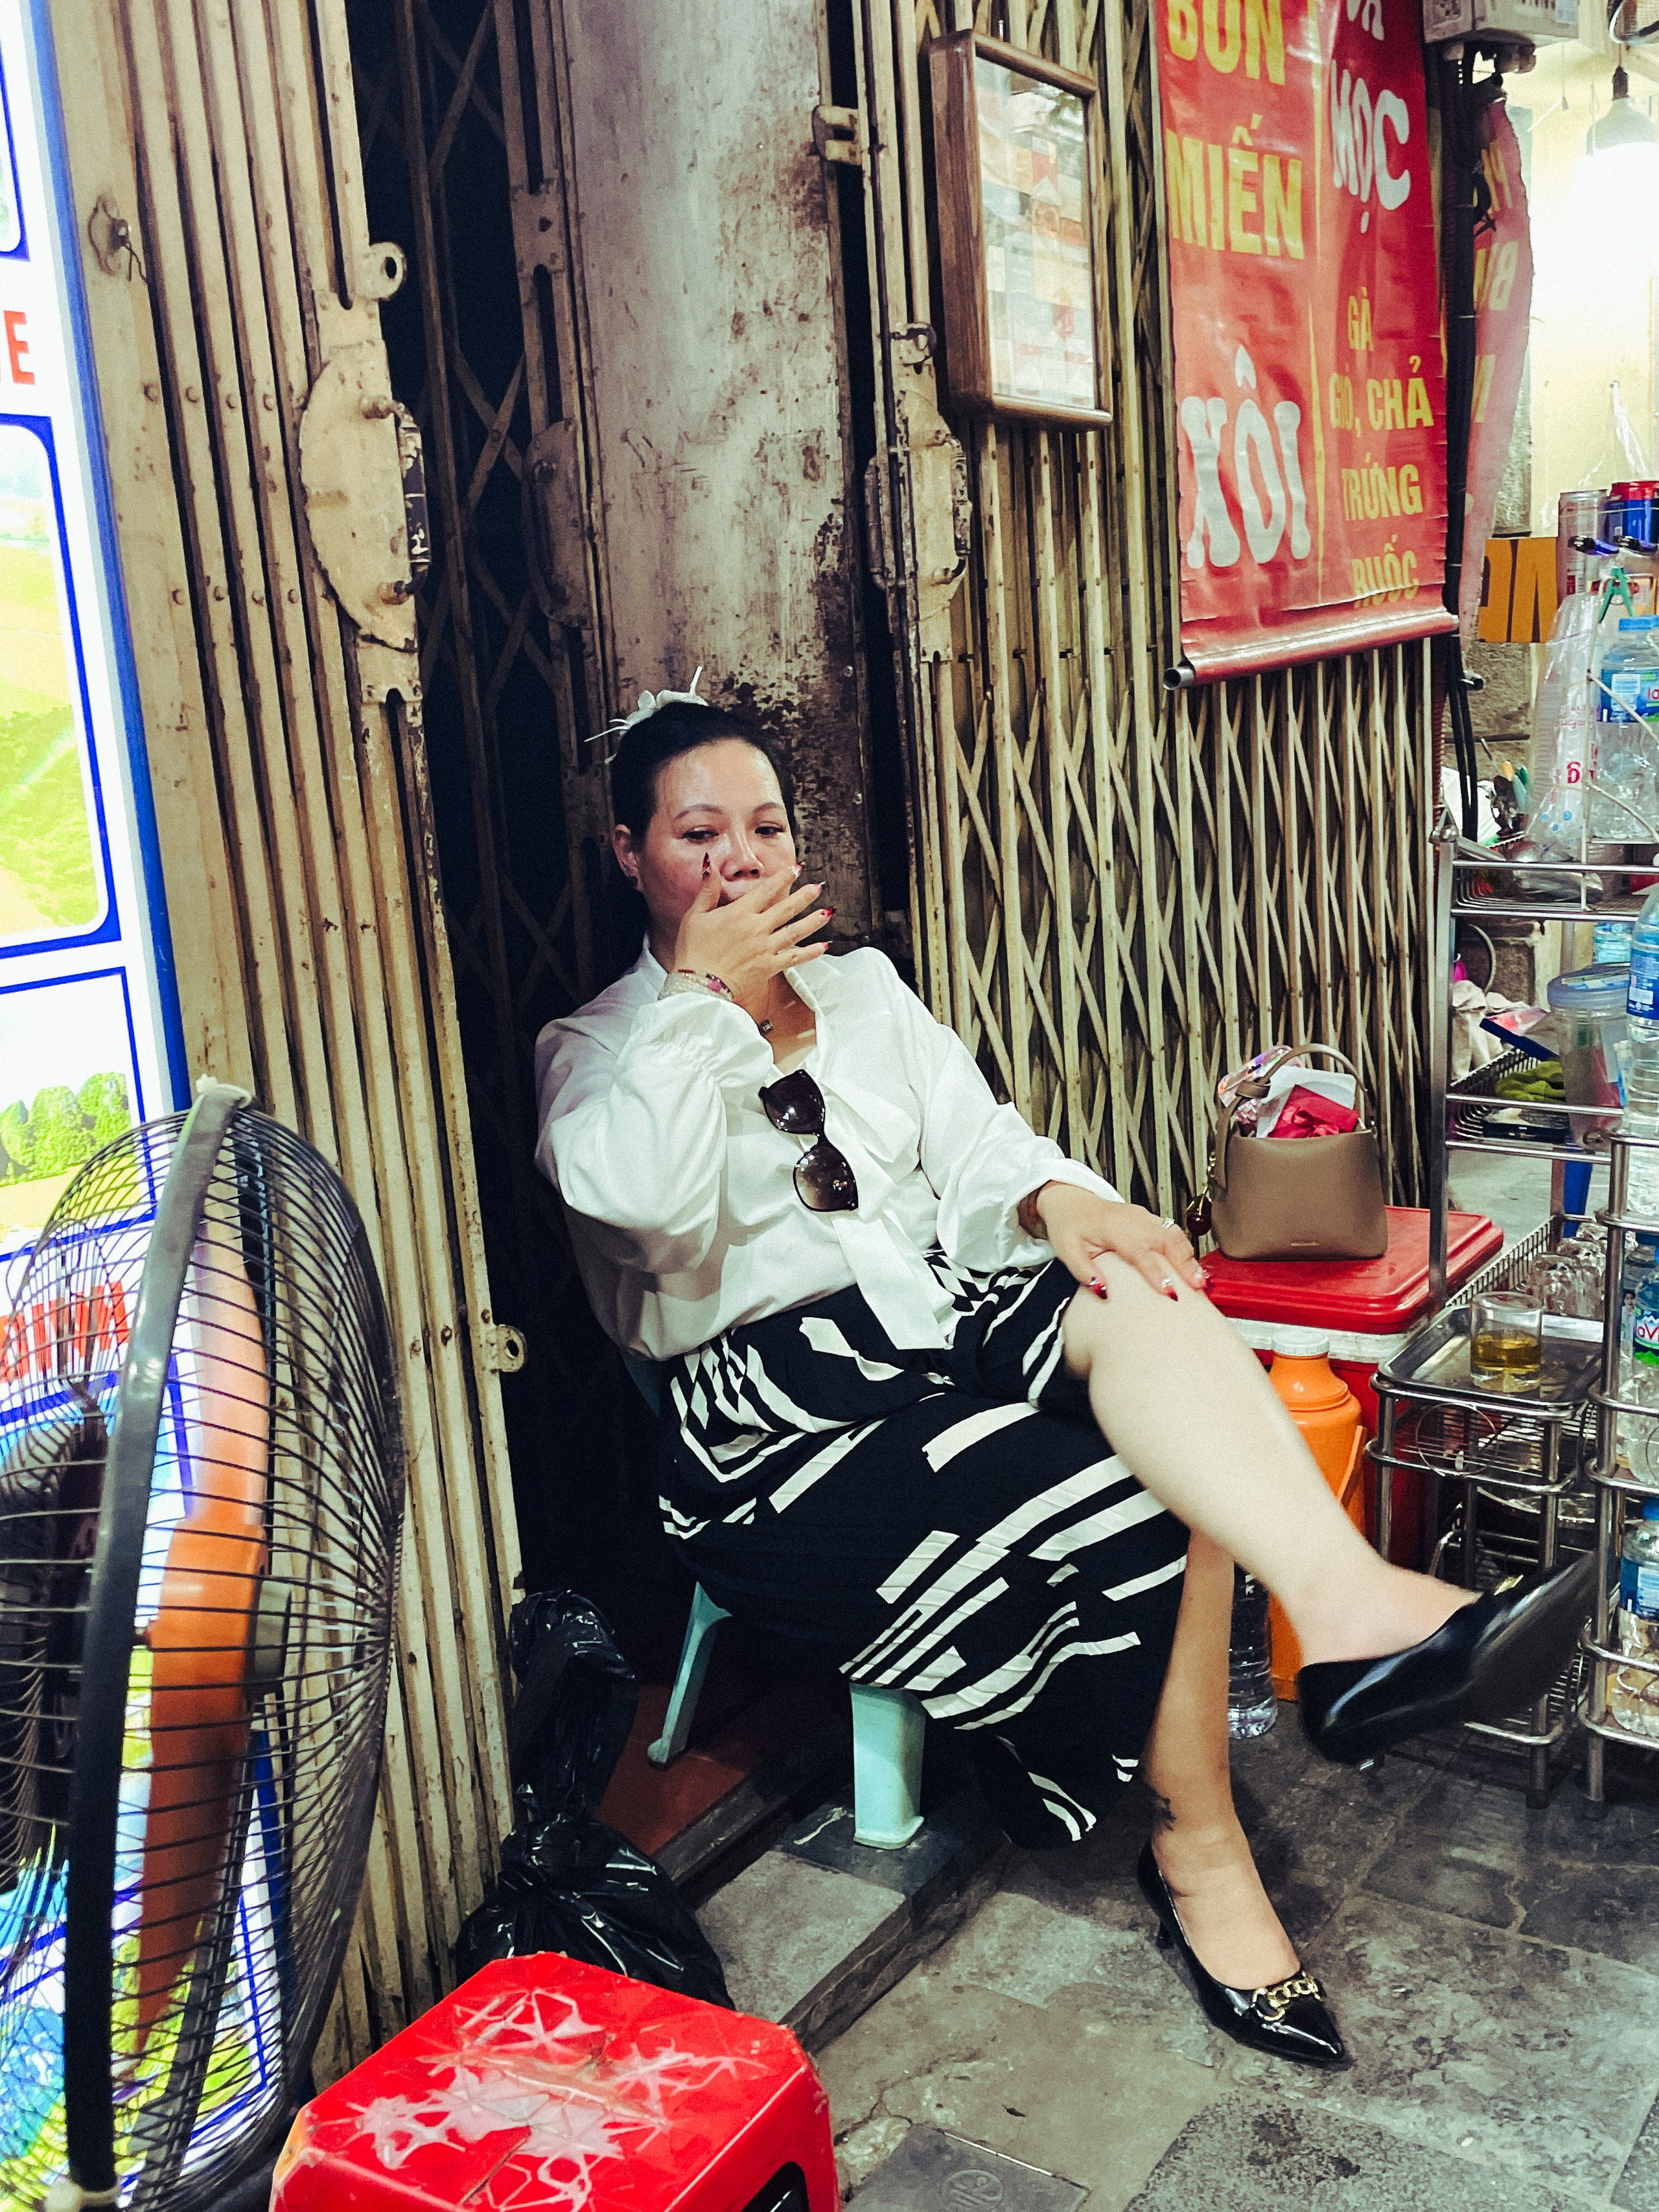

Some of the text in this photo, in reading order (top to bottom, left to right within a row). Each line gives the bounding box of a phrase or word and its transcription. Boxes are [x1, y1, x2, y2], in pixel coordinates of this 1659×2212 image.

[1166, 113, 1305, 259] MIẾN
[1347, 286, 1375, 352] GÀ
[1366, 355, 1434, 431] CHẢ
[1181, 344, 1311, 569] XÔI
[1341, 452, 1423, 521] TRỨNG
[1351, 534, 1419, 609] RUỐC
